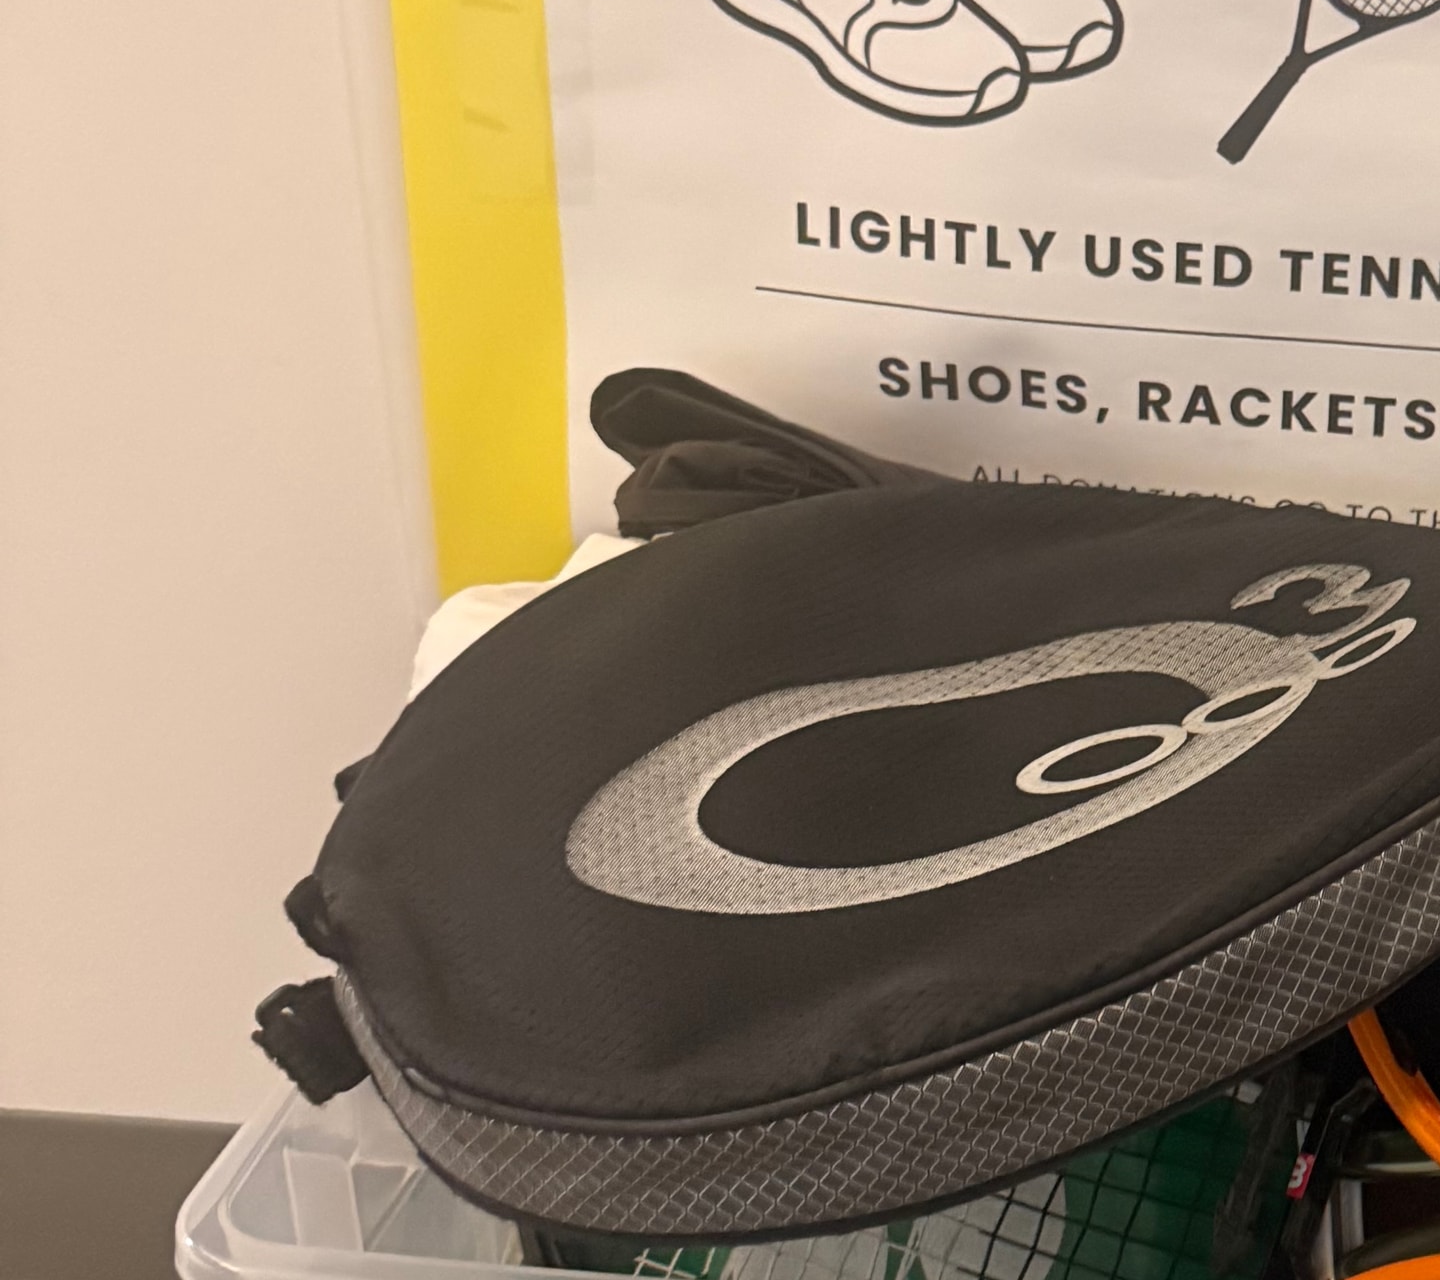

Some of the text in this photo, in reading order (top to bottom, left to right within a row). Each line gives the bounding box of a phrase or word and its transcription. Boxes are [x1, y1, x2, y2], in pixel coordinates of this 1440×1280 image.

[796, 201, 1058, 273] LIGHTLY
[1083, 233, 1253, 287] USED
[877, 356, 1110, 425] SHOES,
